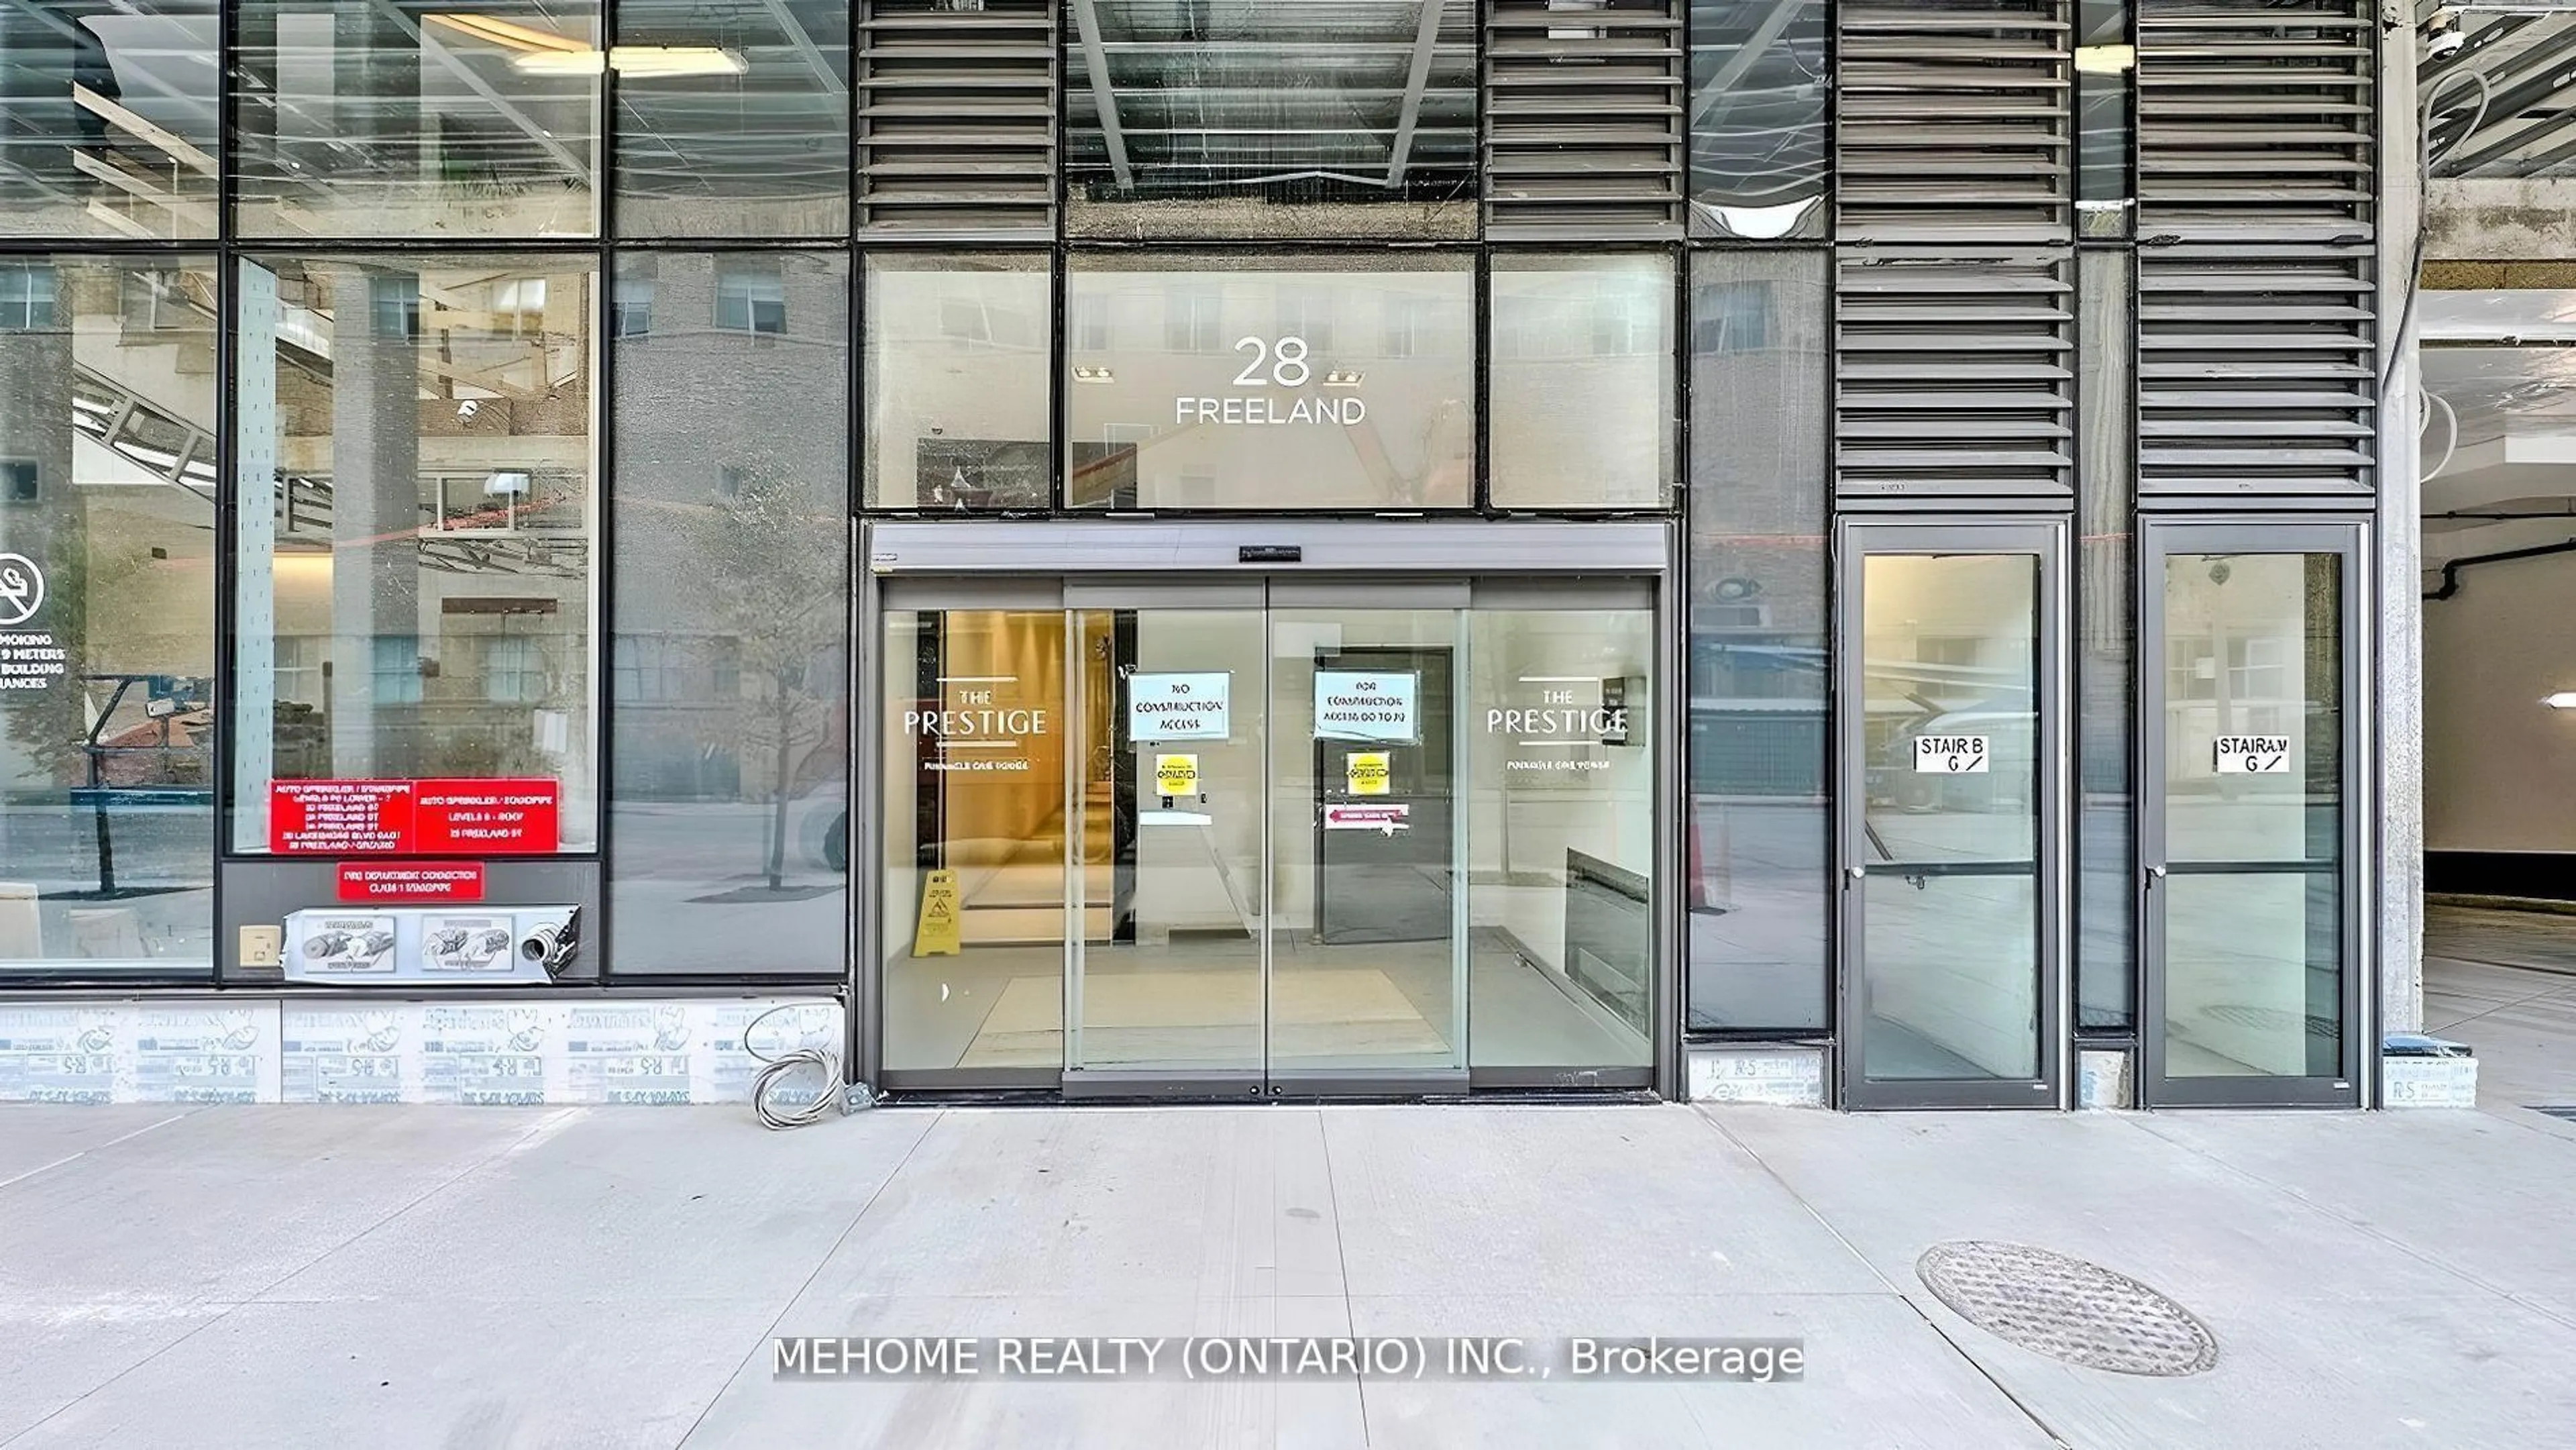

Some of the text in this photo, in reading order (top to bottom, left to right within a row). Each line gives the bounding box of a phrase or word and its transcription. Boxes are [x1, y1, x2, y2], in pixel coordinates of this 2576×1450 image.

[1232, 335, 1310, 387] 28
[1176, 397, 1366, 426] FREELAND
[13, 648, 66, 660] METERS
[1, 663, 64, 675] BUILDING
[1171, 684, 1191, 694] NO
[959, 690, 992, 705] THE
[1328, 696, 1403, 707] CONSTRUCTION
[1543, 690, 1574, 704] THE
[1136, 701, 1224, 713] CONSTRUCTION
[904, 709, 1047, 735] PRESTIGE
[1379, 713, 1392, 722] TO
[1487, 709, 1628, 735] PRESTIGE
[1921, 737, 1983, 754] STAIR B
[1948, 755, 1959, 772] G
[2245, 755, 2258, 772] G
[318, 804, 366, 812] FREELAND
[318, 813, 366, 821] FREELAND
[318, 823, 366, 831] FREELAND
